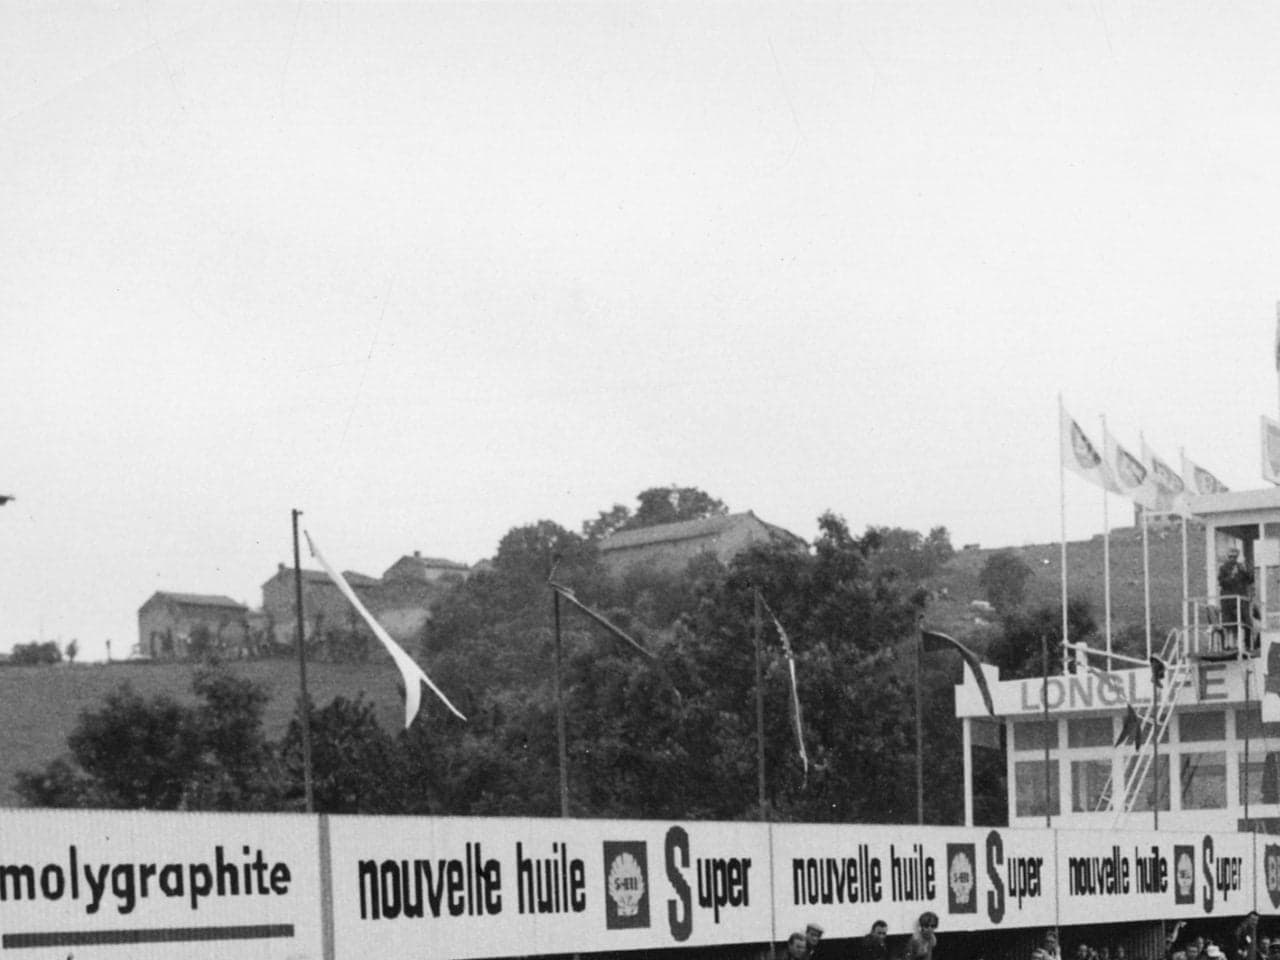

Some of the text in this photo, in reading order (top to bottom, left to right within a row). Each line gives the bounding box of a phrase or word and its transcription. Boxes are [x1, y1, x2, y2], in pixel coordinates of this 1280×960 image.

[1021, 664, 1229, 710] LONGLFE
[0, 845, 292, 914] molygraphite
[358, 841, 502, 920] nouvelle
[516, 841, 586, 914] huile
[664, 825, 752, 942] Super
[792, 844, 883, 905] nouvelle
[890, 844, 936, 902] huile
[985, 830, 1043, 925] Super
[1068, 834, 1243, 914] nouvelle huile Super
